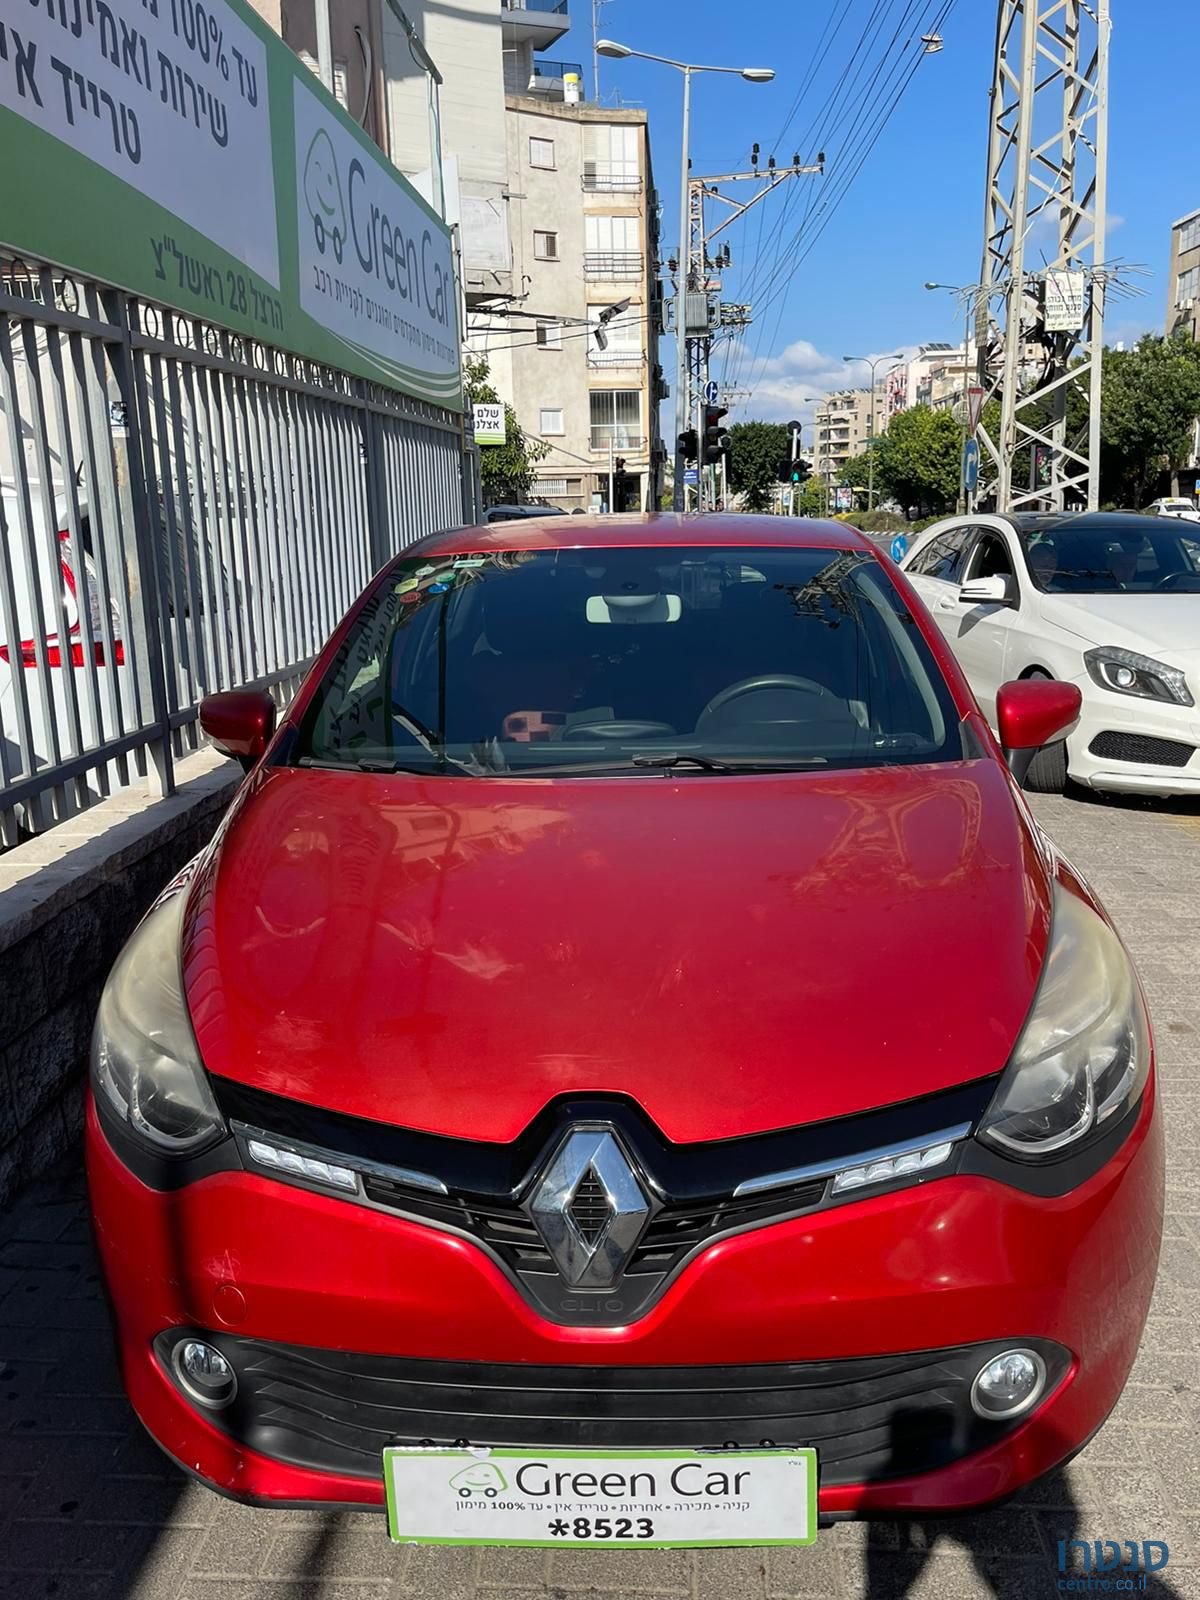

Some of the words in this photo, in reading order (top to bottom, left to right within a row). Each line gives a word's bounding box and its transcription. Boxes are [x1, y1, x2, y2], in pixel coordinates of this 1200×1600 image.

[170, 0, 229, 81] 100%
[231, 45, 258, 108] עד
[157, 49, 228, 148] שירות
[50, 55, 142, 165] טרייד
[348, 158, 421, 309] Green
[421, 229, 449, 328] Car
[313, 265, 333, 297] רכב
[227, 270, 248, 315] 28
[334, 278, 363, 318] לקניית
[249, 277, 283, 331] הרצל
[477, 407, 499, 418] שלם
[475, 419, 500, 430] אצלנ
[560, 1300, 624, 1312] CLIO
[515, 1462, 656, 1497] Green
[670, 1462, 751, 1497] Car
[456, 1501, 487, 1511] מימון
[491, 1502, 526, 1510] 100%
[528, 1502, 543, 1511] עד
[555, 1503, 572, 1513] אין
[577, 1503, 609, 1512] טרייד
[620, 1503, 663, 1512] אחריות
[674, 1502, 711, 1512] מכירה
[723, 1501, 750, 1512] קניה
